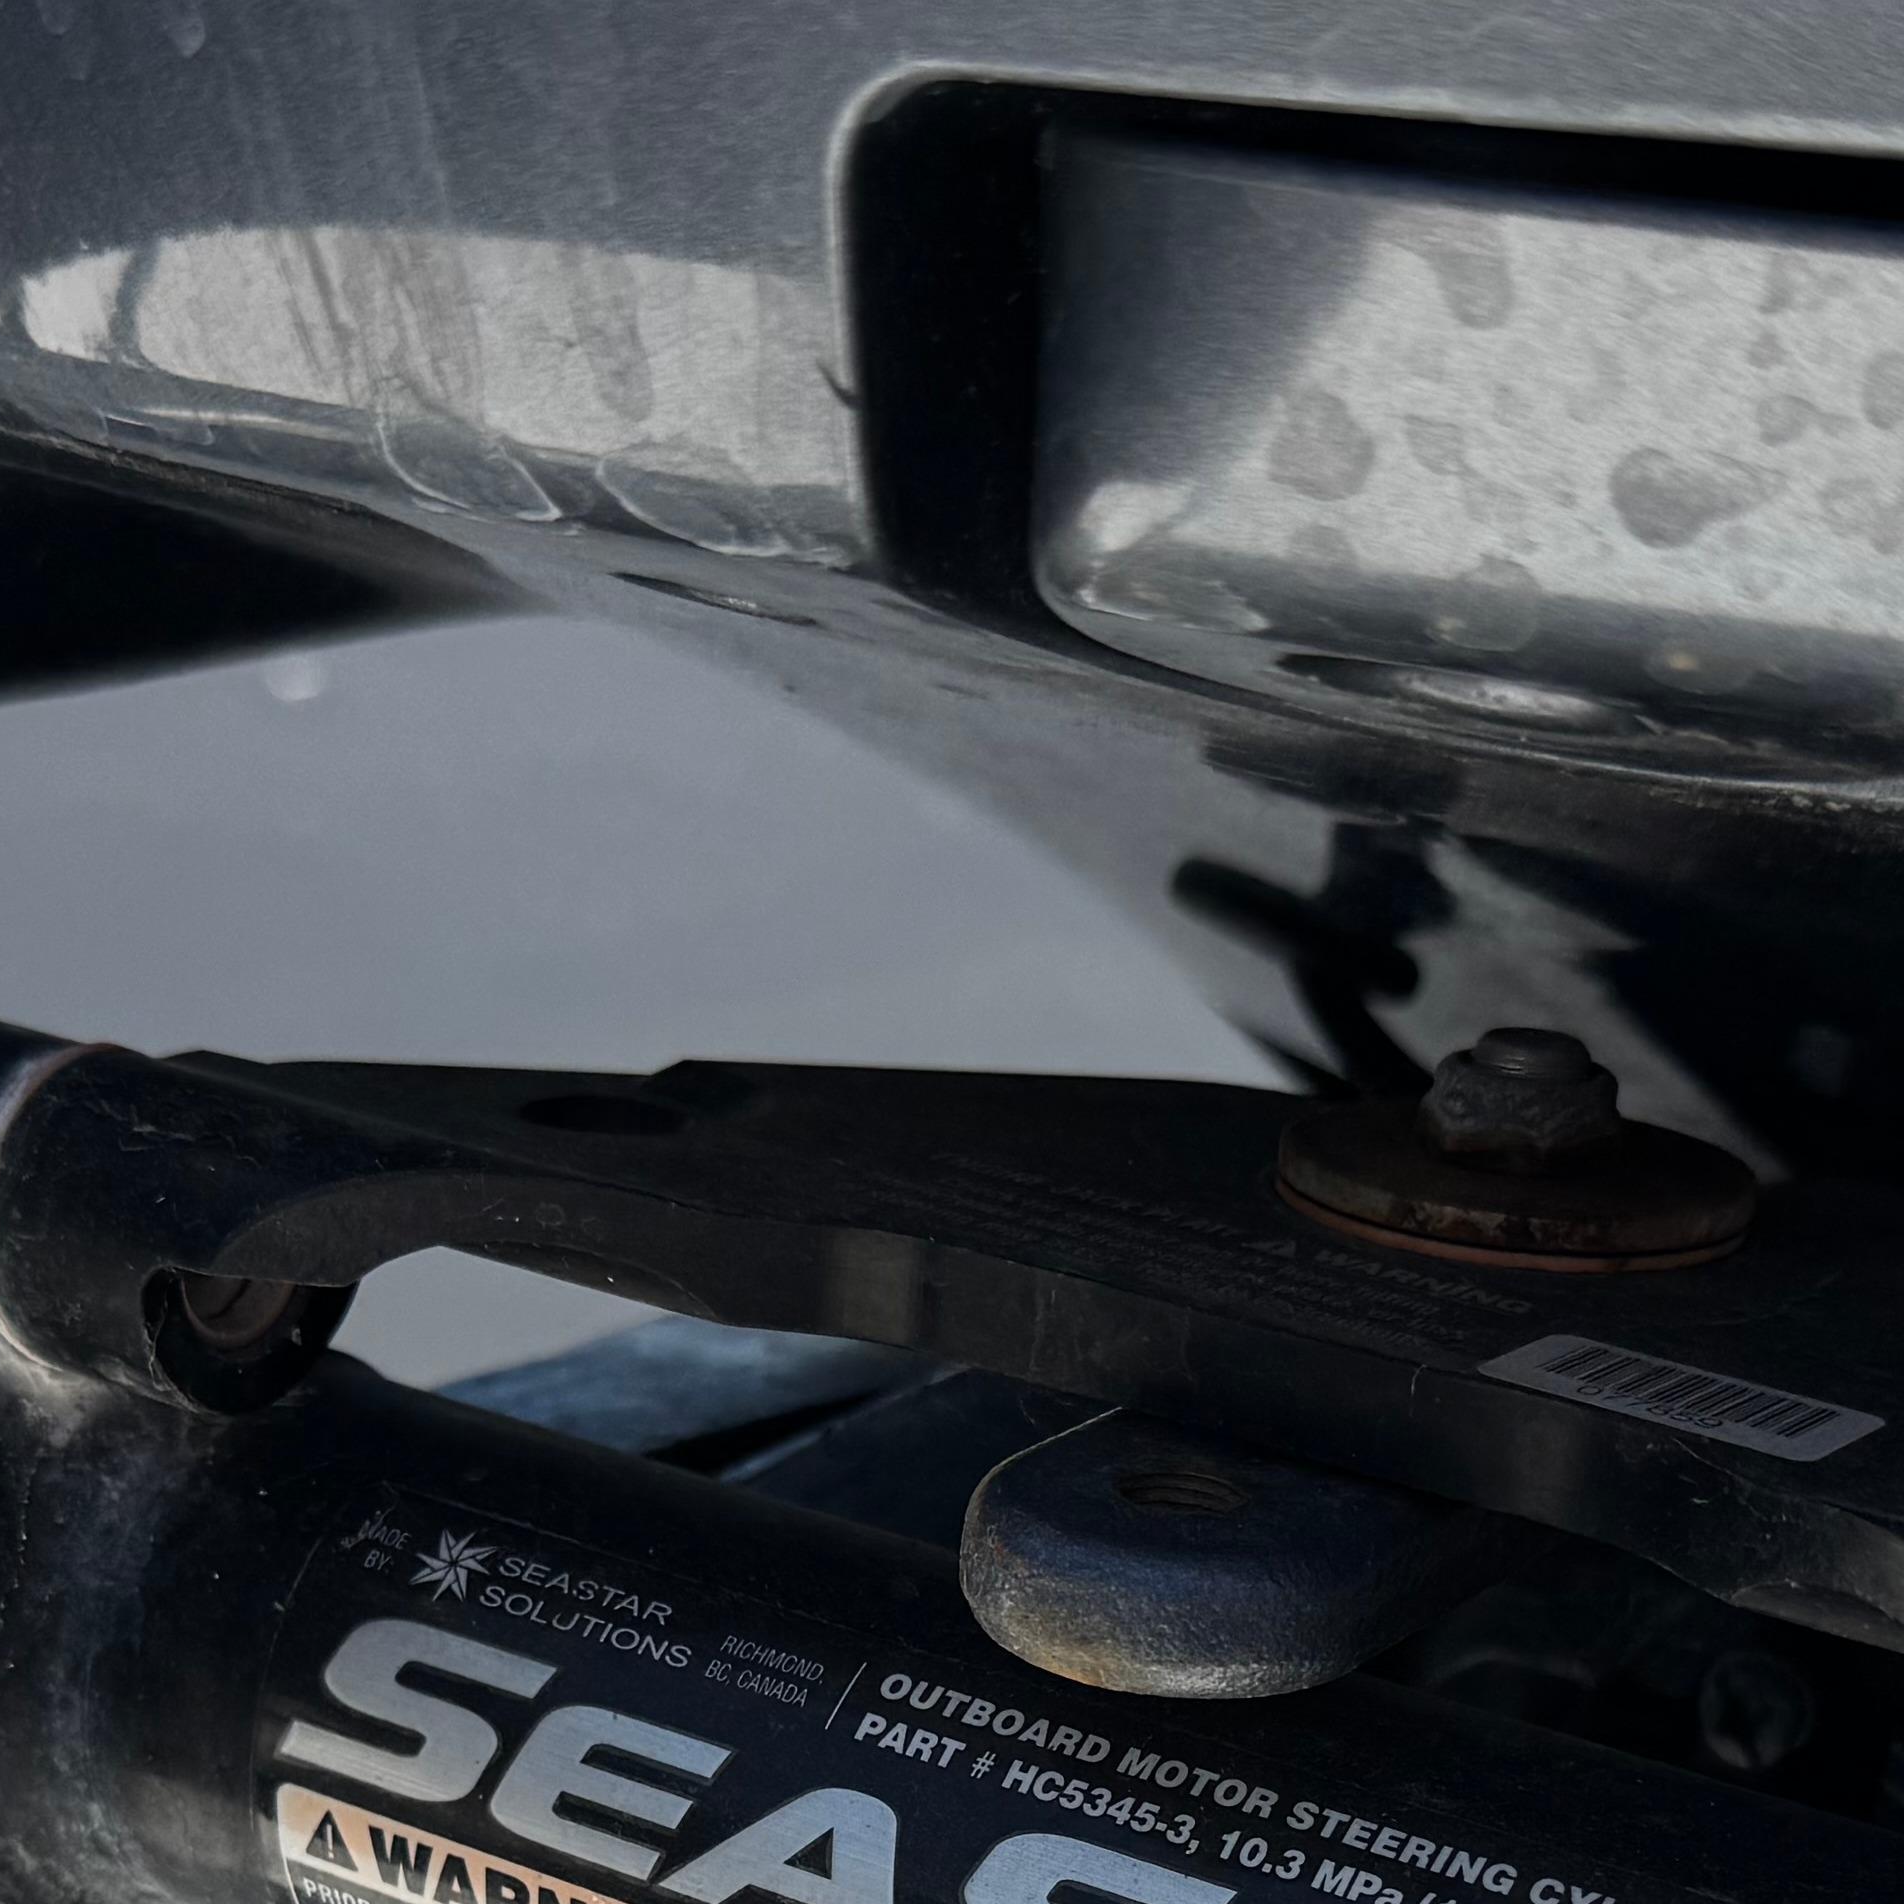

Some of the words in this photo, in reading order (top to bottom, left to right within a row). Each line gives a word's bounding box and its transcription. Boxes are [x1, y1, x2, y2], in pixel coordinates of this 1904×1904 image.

[479, 1586, 692, 1668] SOLUTIONS
[497, 1556, 673, 1625] SEASTAR
[737, 1671, 809, 1707] CANADA
[853, 1712, 966, 1769] PART
[970, 1751, 995, 1779] #
[1001, 1760, 1200, 1855] HC5345-3,
[1219, 1831, 1306, 1880] 10.3
[879, 1674, 1111, 1763] OUTBOARD
[1116, 1746, 1280, 1819] MOTOR
[1286, 1801, 1518, 1896] STEERING
